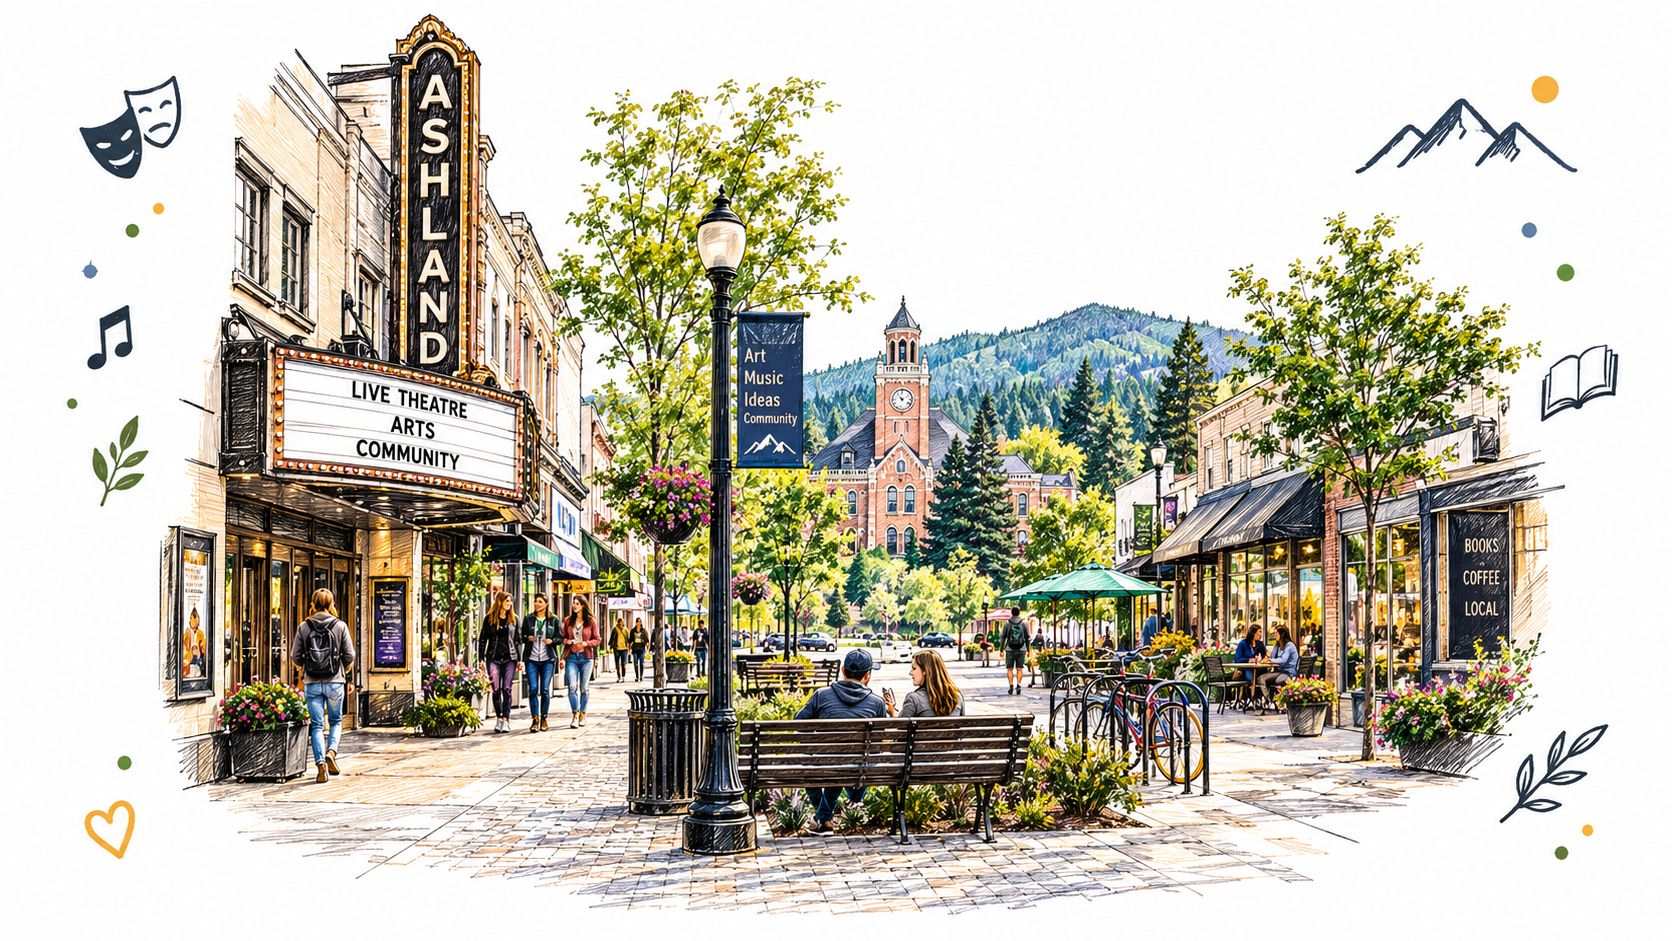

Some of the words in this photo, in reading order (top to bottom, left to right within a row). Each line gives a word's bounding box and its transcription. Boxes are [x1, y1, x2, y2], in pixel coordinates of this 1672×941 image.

[417, 74, 453, 364] ASHLAND
[744, 348, 766, 363] Art
[744, 370, 784, 385] Music
[352, 380, 391, 404] LIVE
[398, 388, 468, 419] THEATRE
[744, 391, 781, 407] Ideas
[743, 412, 798, 427] Community
[390, 416, 435, 440] ARTS
[356, 439, 460, 470] COMMUNITY
[1464, 538, 1500, 553] BOOKS
[1463, 570, 1500, 585] COFFEE
[1465, 601, 1499, 616] LOCAL
